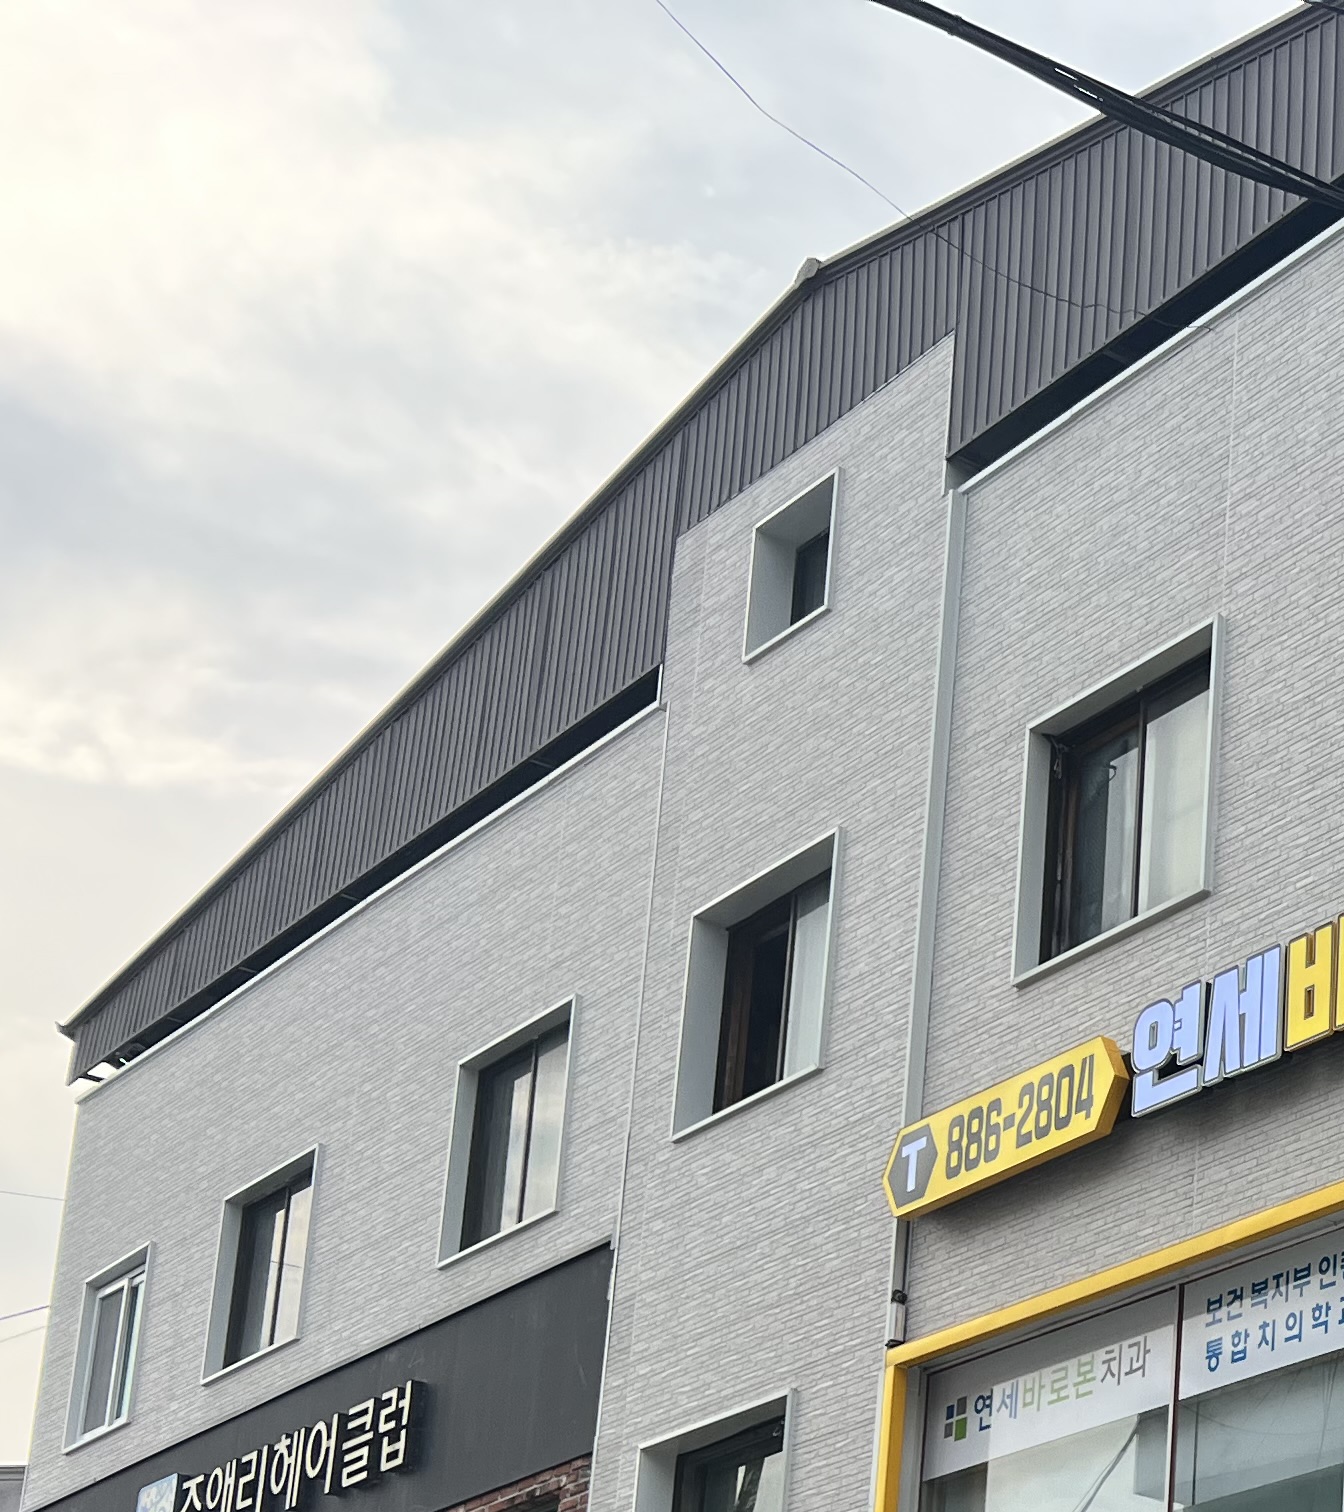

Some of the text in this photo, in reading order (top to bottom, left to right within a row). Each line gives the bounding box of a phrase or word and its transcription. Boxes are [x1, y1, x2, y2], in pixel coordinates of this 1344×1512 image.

[900, 1055, 1094, 1192] T 886-2804
[974, 1335, 1151, 1432] 연세바로본치과
